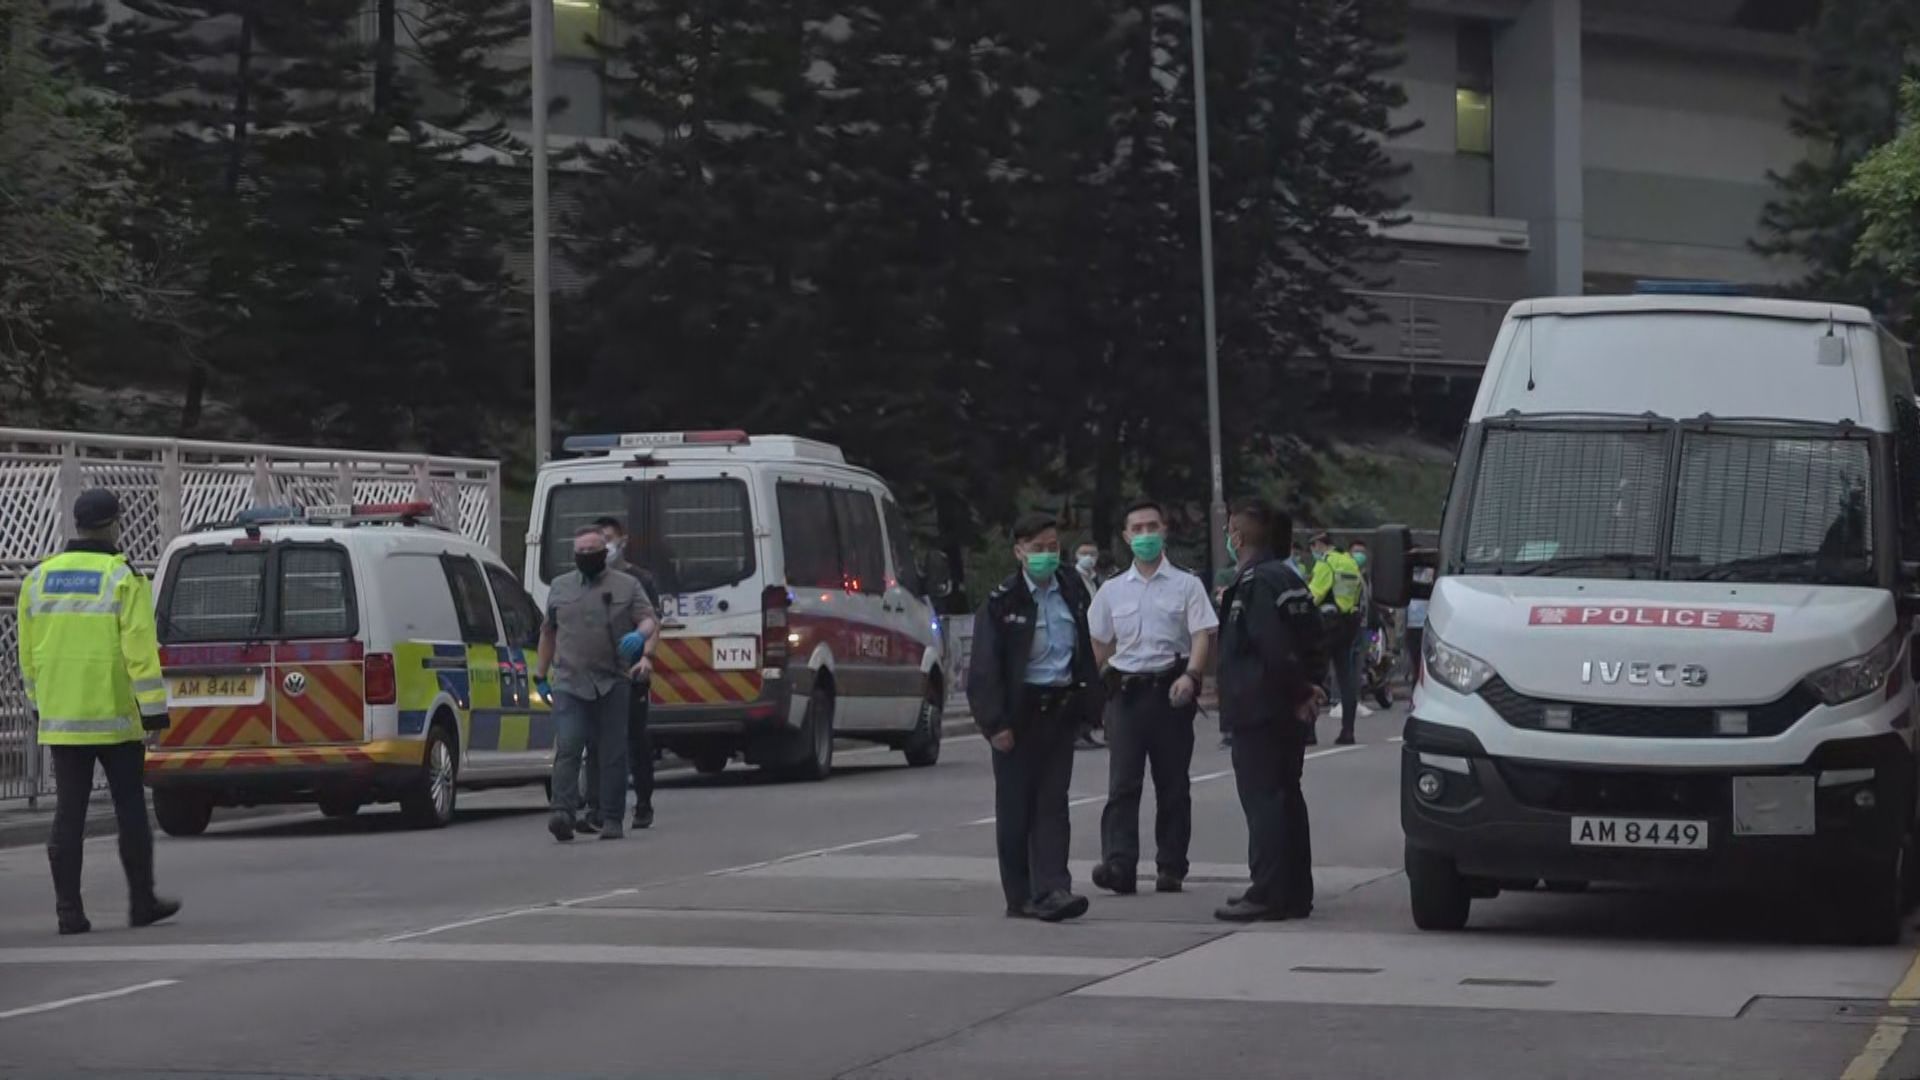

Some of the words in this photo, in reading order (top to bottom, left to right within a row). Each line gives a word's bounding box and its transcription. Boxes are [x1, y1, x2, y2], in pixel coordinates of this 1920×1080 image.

[1581, 607, 1723, 628] POLICE
[716, 648, 752, 662] NTN
[1581, 660, 1709, 688] IVECO
[179, 679, 201, 696] AM
[207, 676, 248, 695] 8414
[1579, 819, 1616, 843] AM
[1624, 822, 1700, 846] 8449
